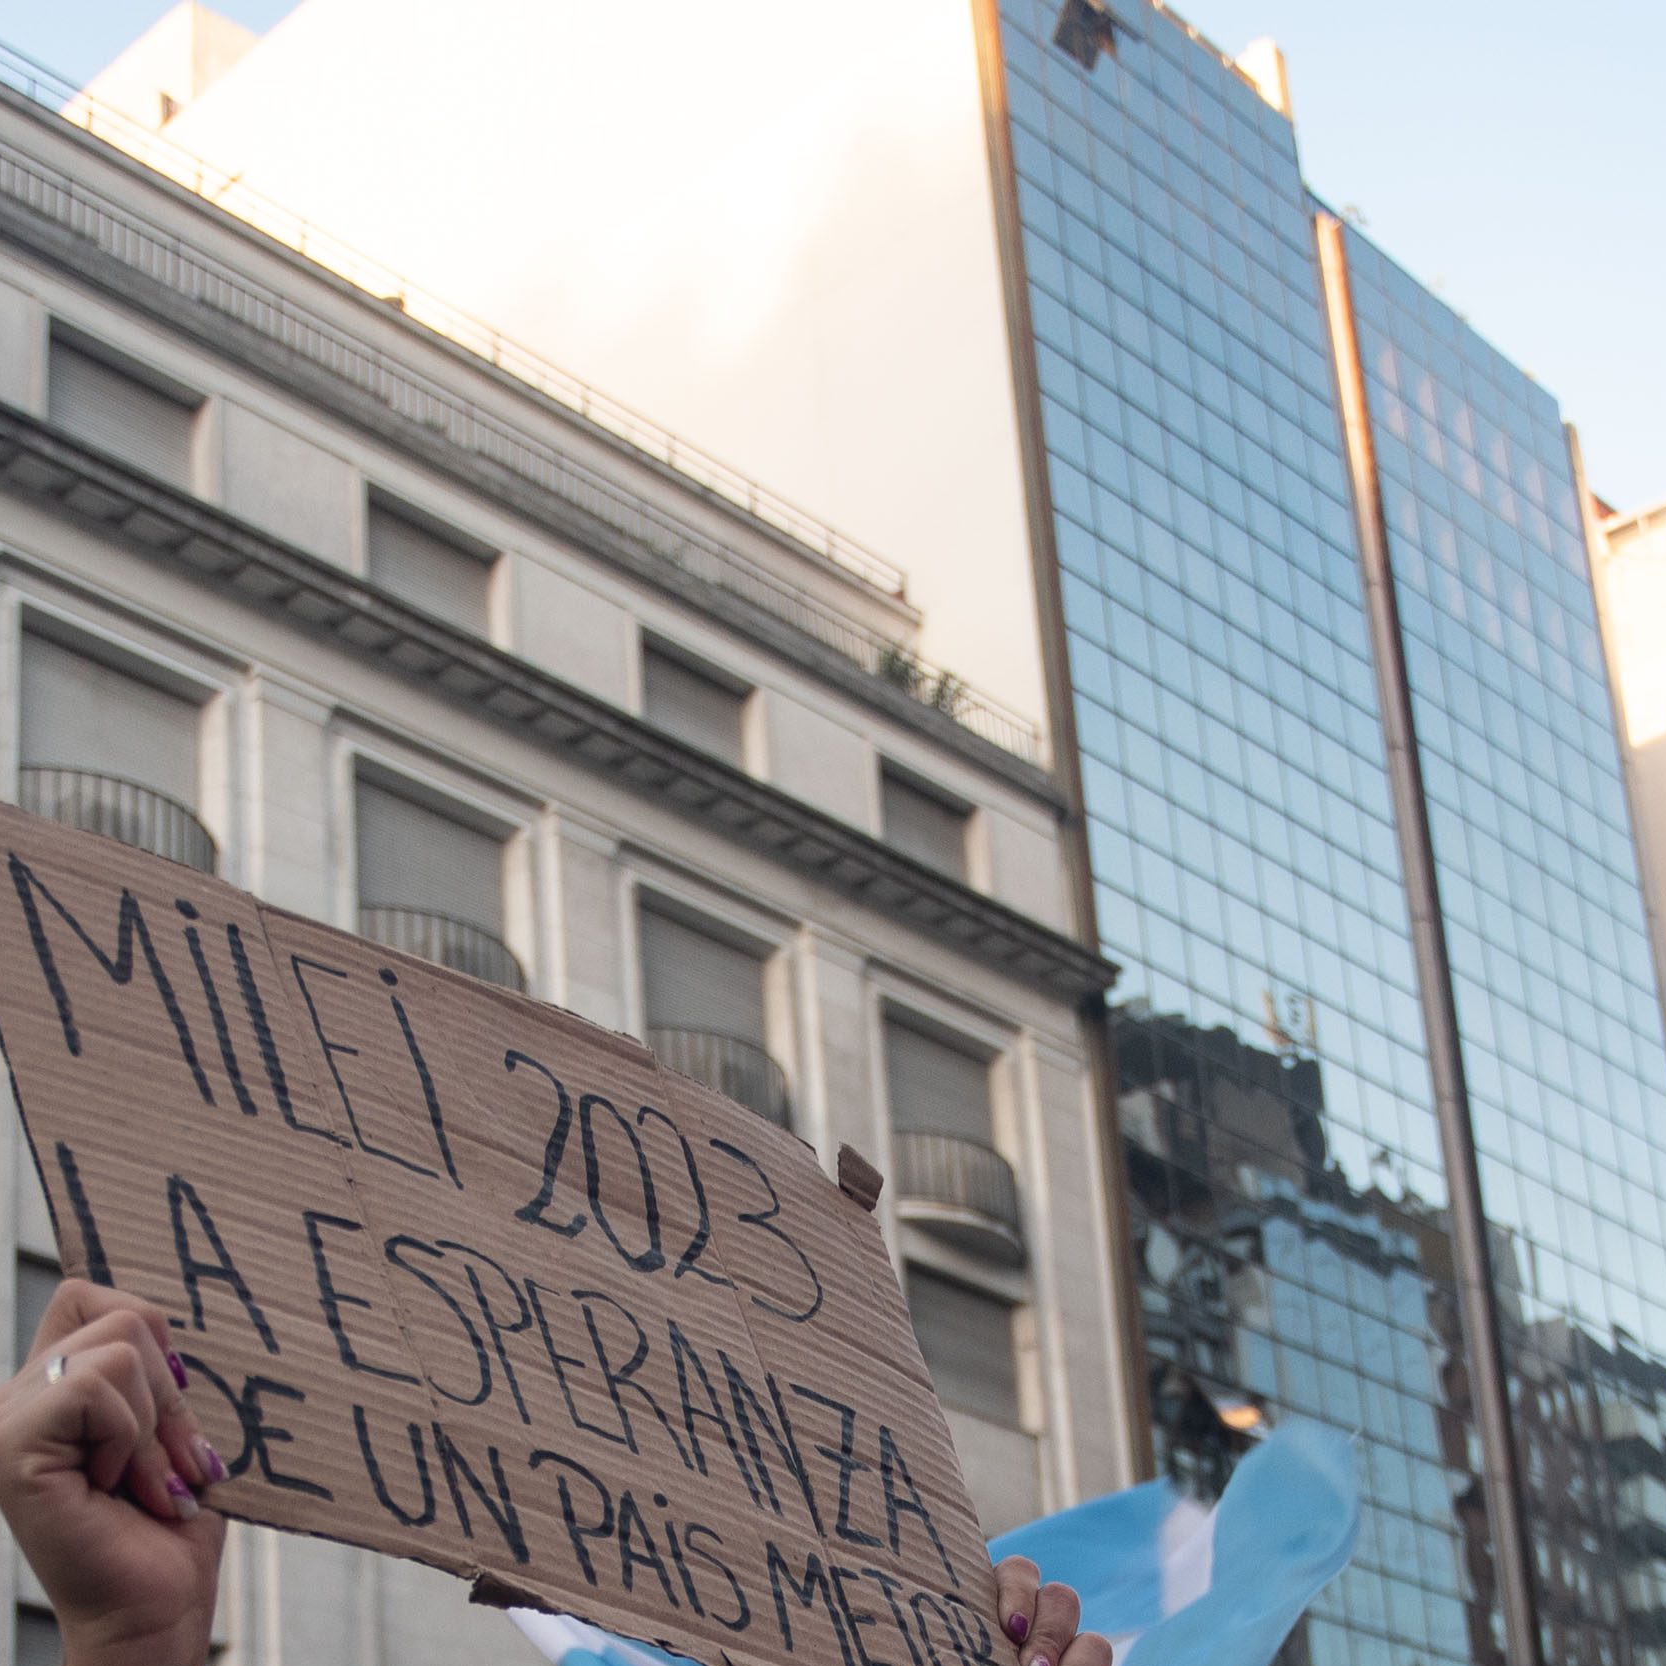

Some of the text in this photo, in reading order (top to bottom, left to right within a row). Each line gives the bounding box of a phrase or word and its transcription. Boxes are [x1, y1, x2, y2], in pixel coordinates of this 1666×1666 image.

[503, 1048, 824, 1323] 2023
[54, 1140, 960, 1590] LA ESPERANZA
[352, 1403, 530, 1565] UN
